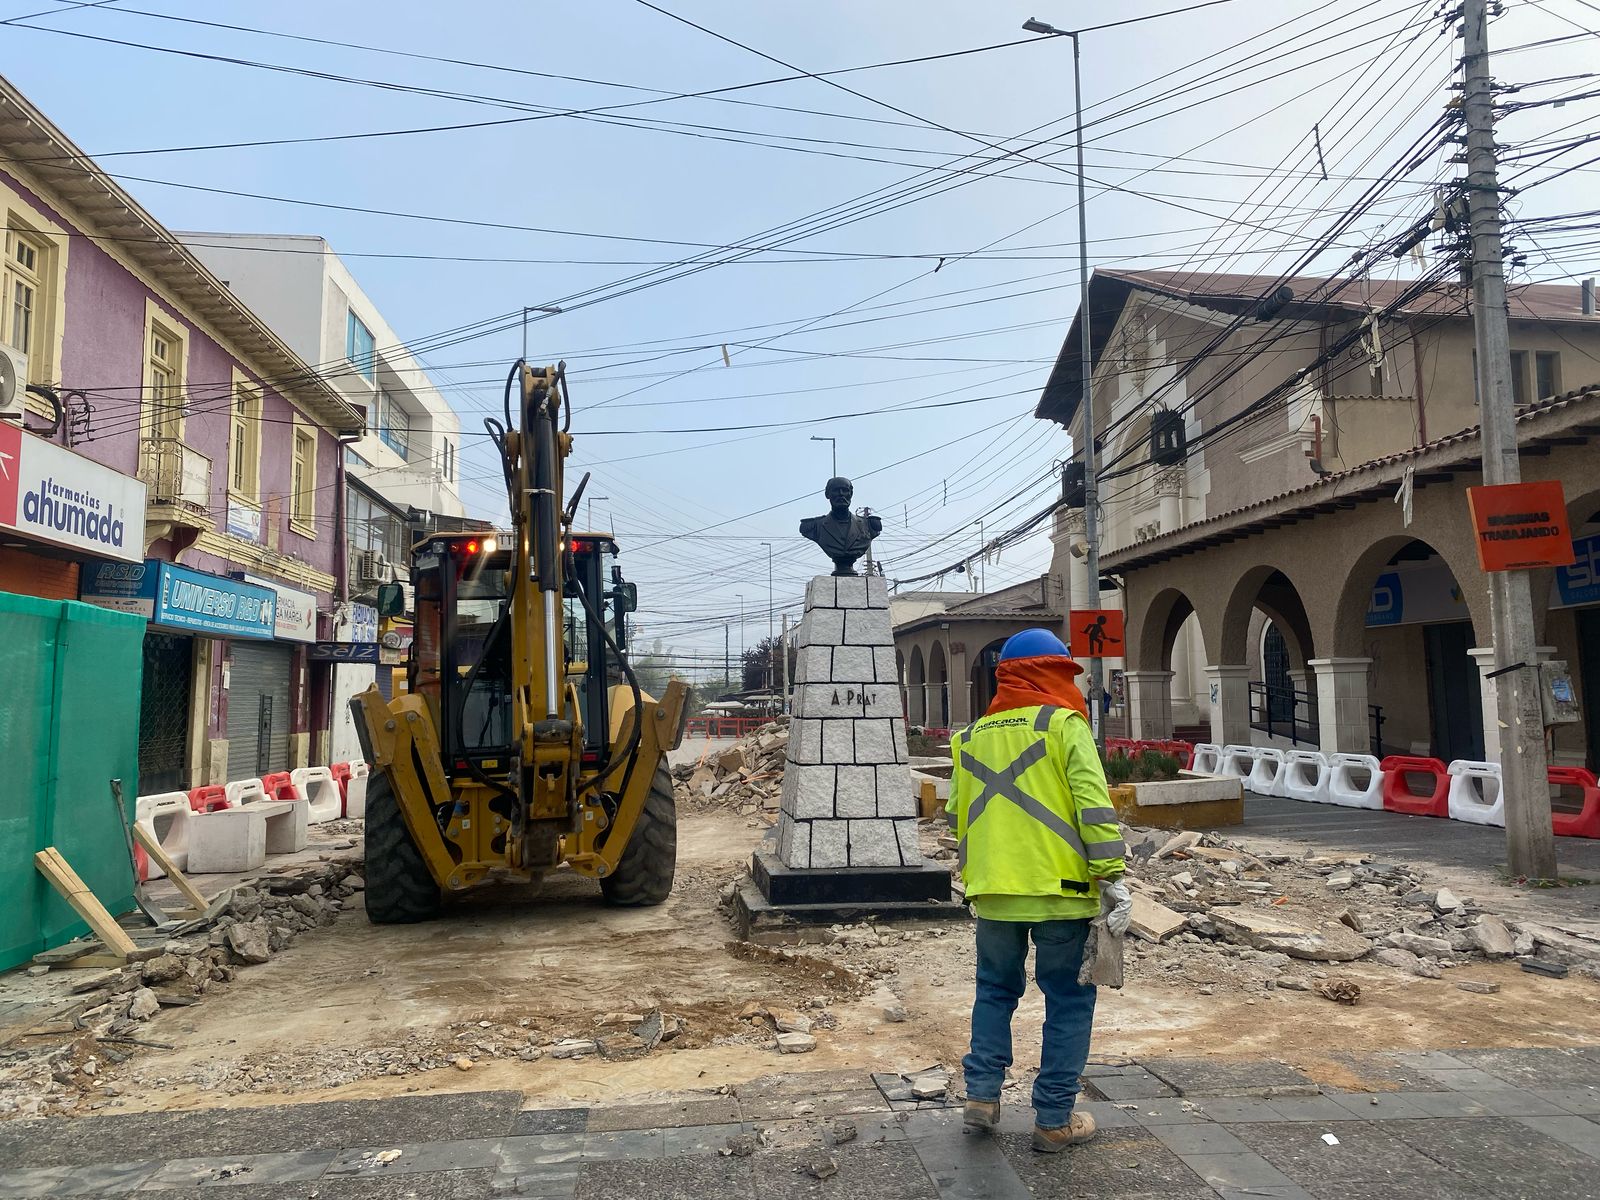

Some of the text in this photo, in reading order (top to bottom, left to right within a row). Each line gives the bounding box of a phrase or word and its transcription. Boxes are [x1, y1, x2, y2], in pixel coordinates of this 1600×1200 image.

[47, 477, 100, 510] farmacias
[23, 479, 124, 548] ahumada
[1480, 526, 1560, 542] TRABAJANDO
[96, 562, 146, 581] R&D
[171, 579, 237, 619] UNIVERSO
[277, 596, 296, 609] RMACIA
[975, 717, 1029, 731] MERCADAL
